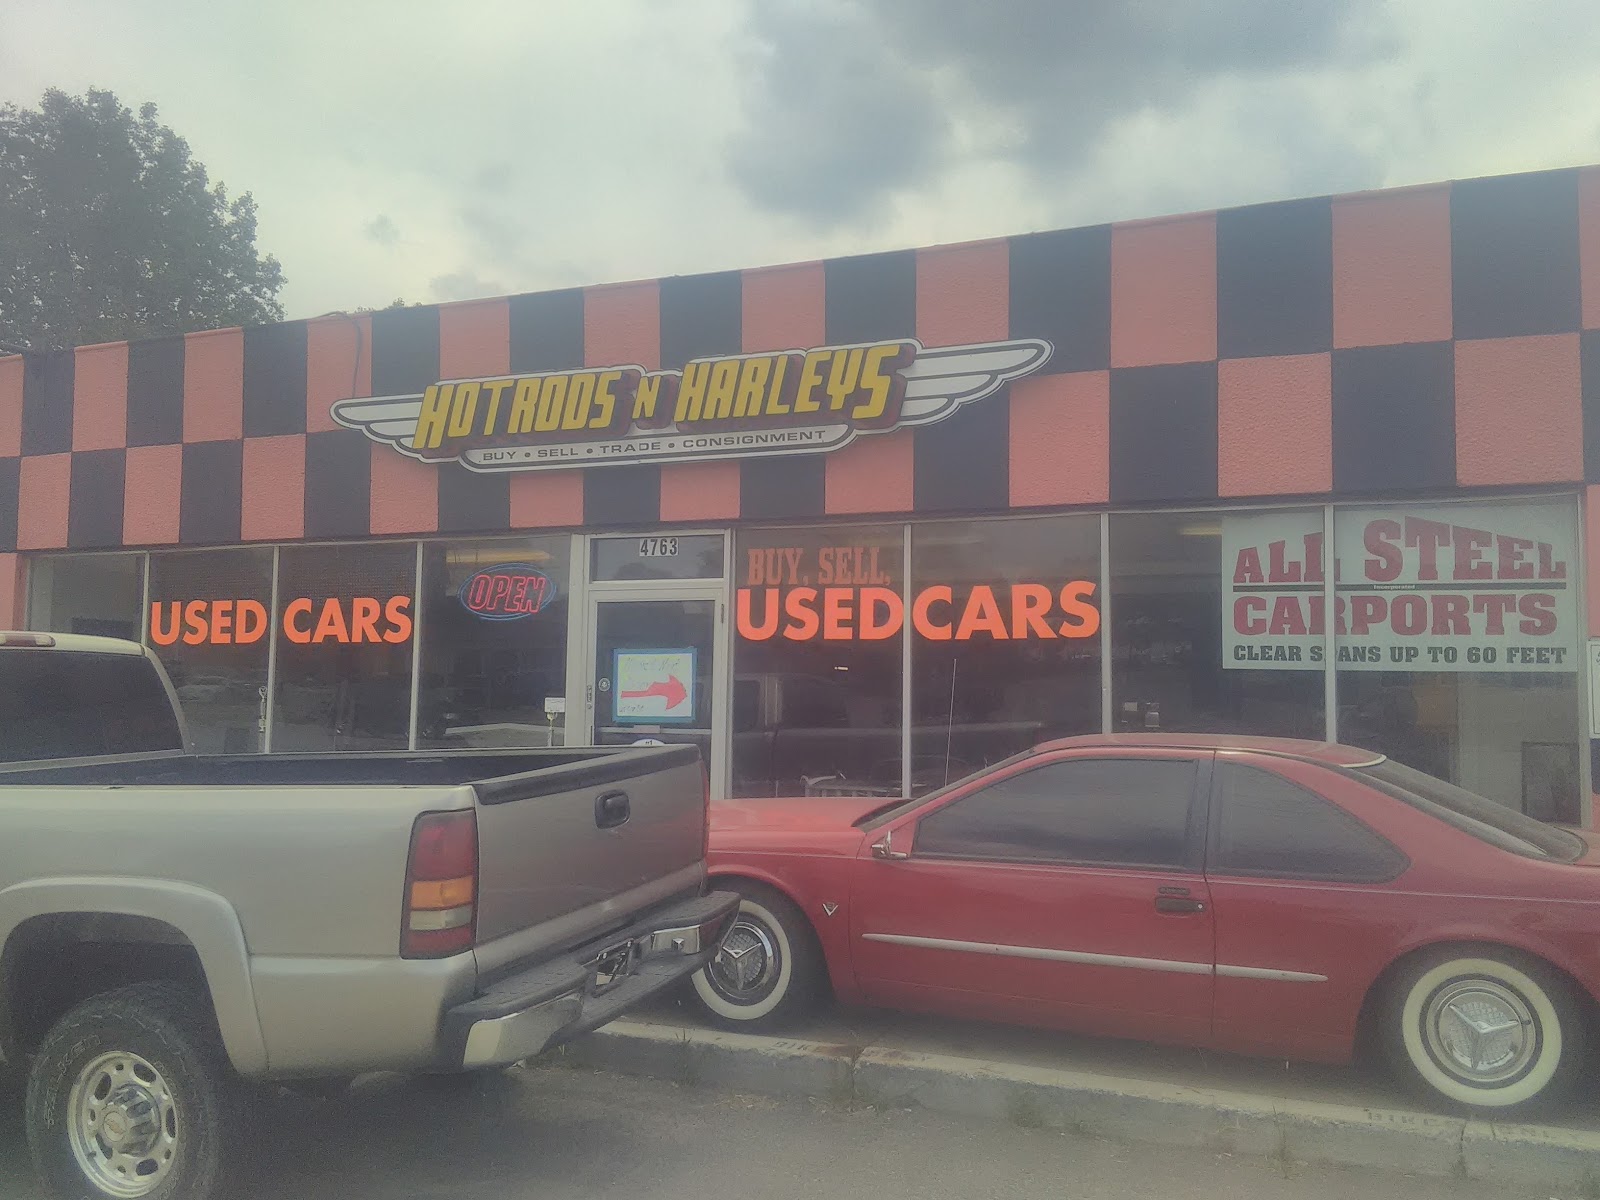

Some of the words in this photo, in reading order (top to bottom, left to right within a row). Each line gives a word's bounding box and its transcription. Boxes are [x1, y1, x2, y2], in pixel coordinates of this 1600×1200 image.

[632, 375, 661, 419] N
[673, 345, 900, 422] HARLEYS
[483, 451, 517, 461] BUY
[537, 448, 579, 458] SELL
[599, 441, 661, 453] TRADE
[682, 430, 826, 448] CONSIGNMENT
[640, 538, 678, 556] 4763
[1232, 531, 1341, 584] ALL
[1363, 515, 1567, 583] STEEL
[468, 574, 548, 614] OPEN
[737, 587, 904, 641] USED
[912, 581, 1101, 640] CARS
[1233, 593, 1558, 636] CARPORTS
[150, 600, 268, 645] USED
[283, 595, 412, 644] CARS
[1233, 645, 1302, 662] CLEAR
[1310, 645, 1381, 663] SANS
[1389, 646, 1420, 663] UP
[1427, 646, 1458, 664] TO
[1466, 646, 1497, 664] 60
[1506, 647, 1567, 665] FEET
